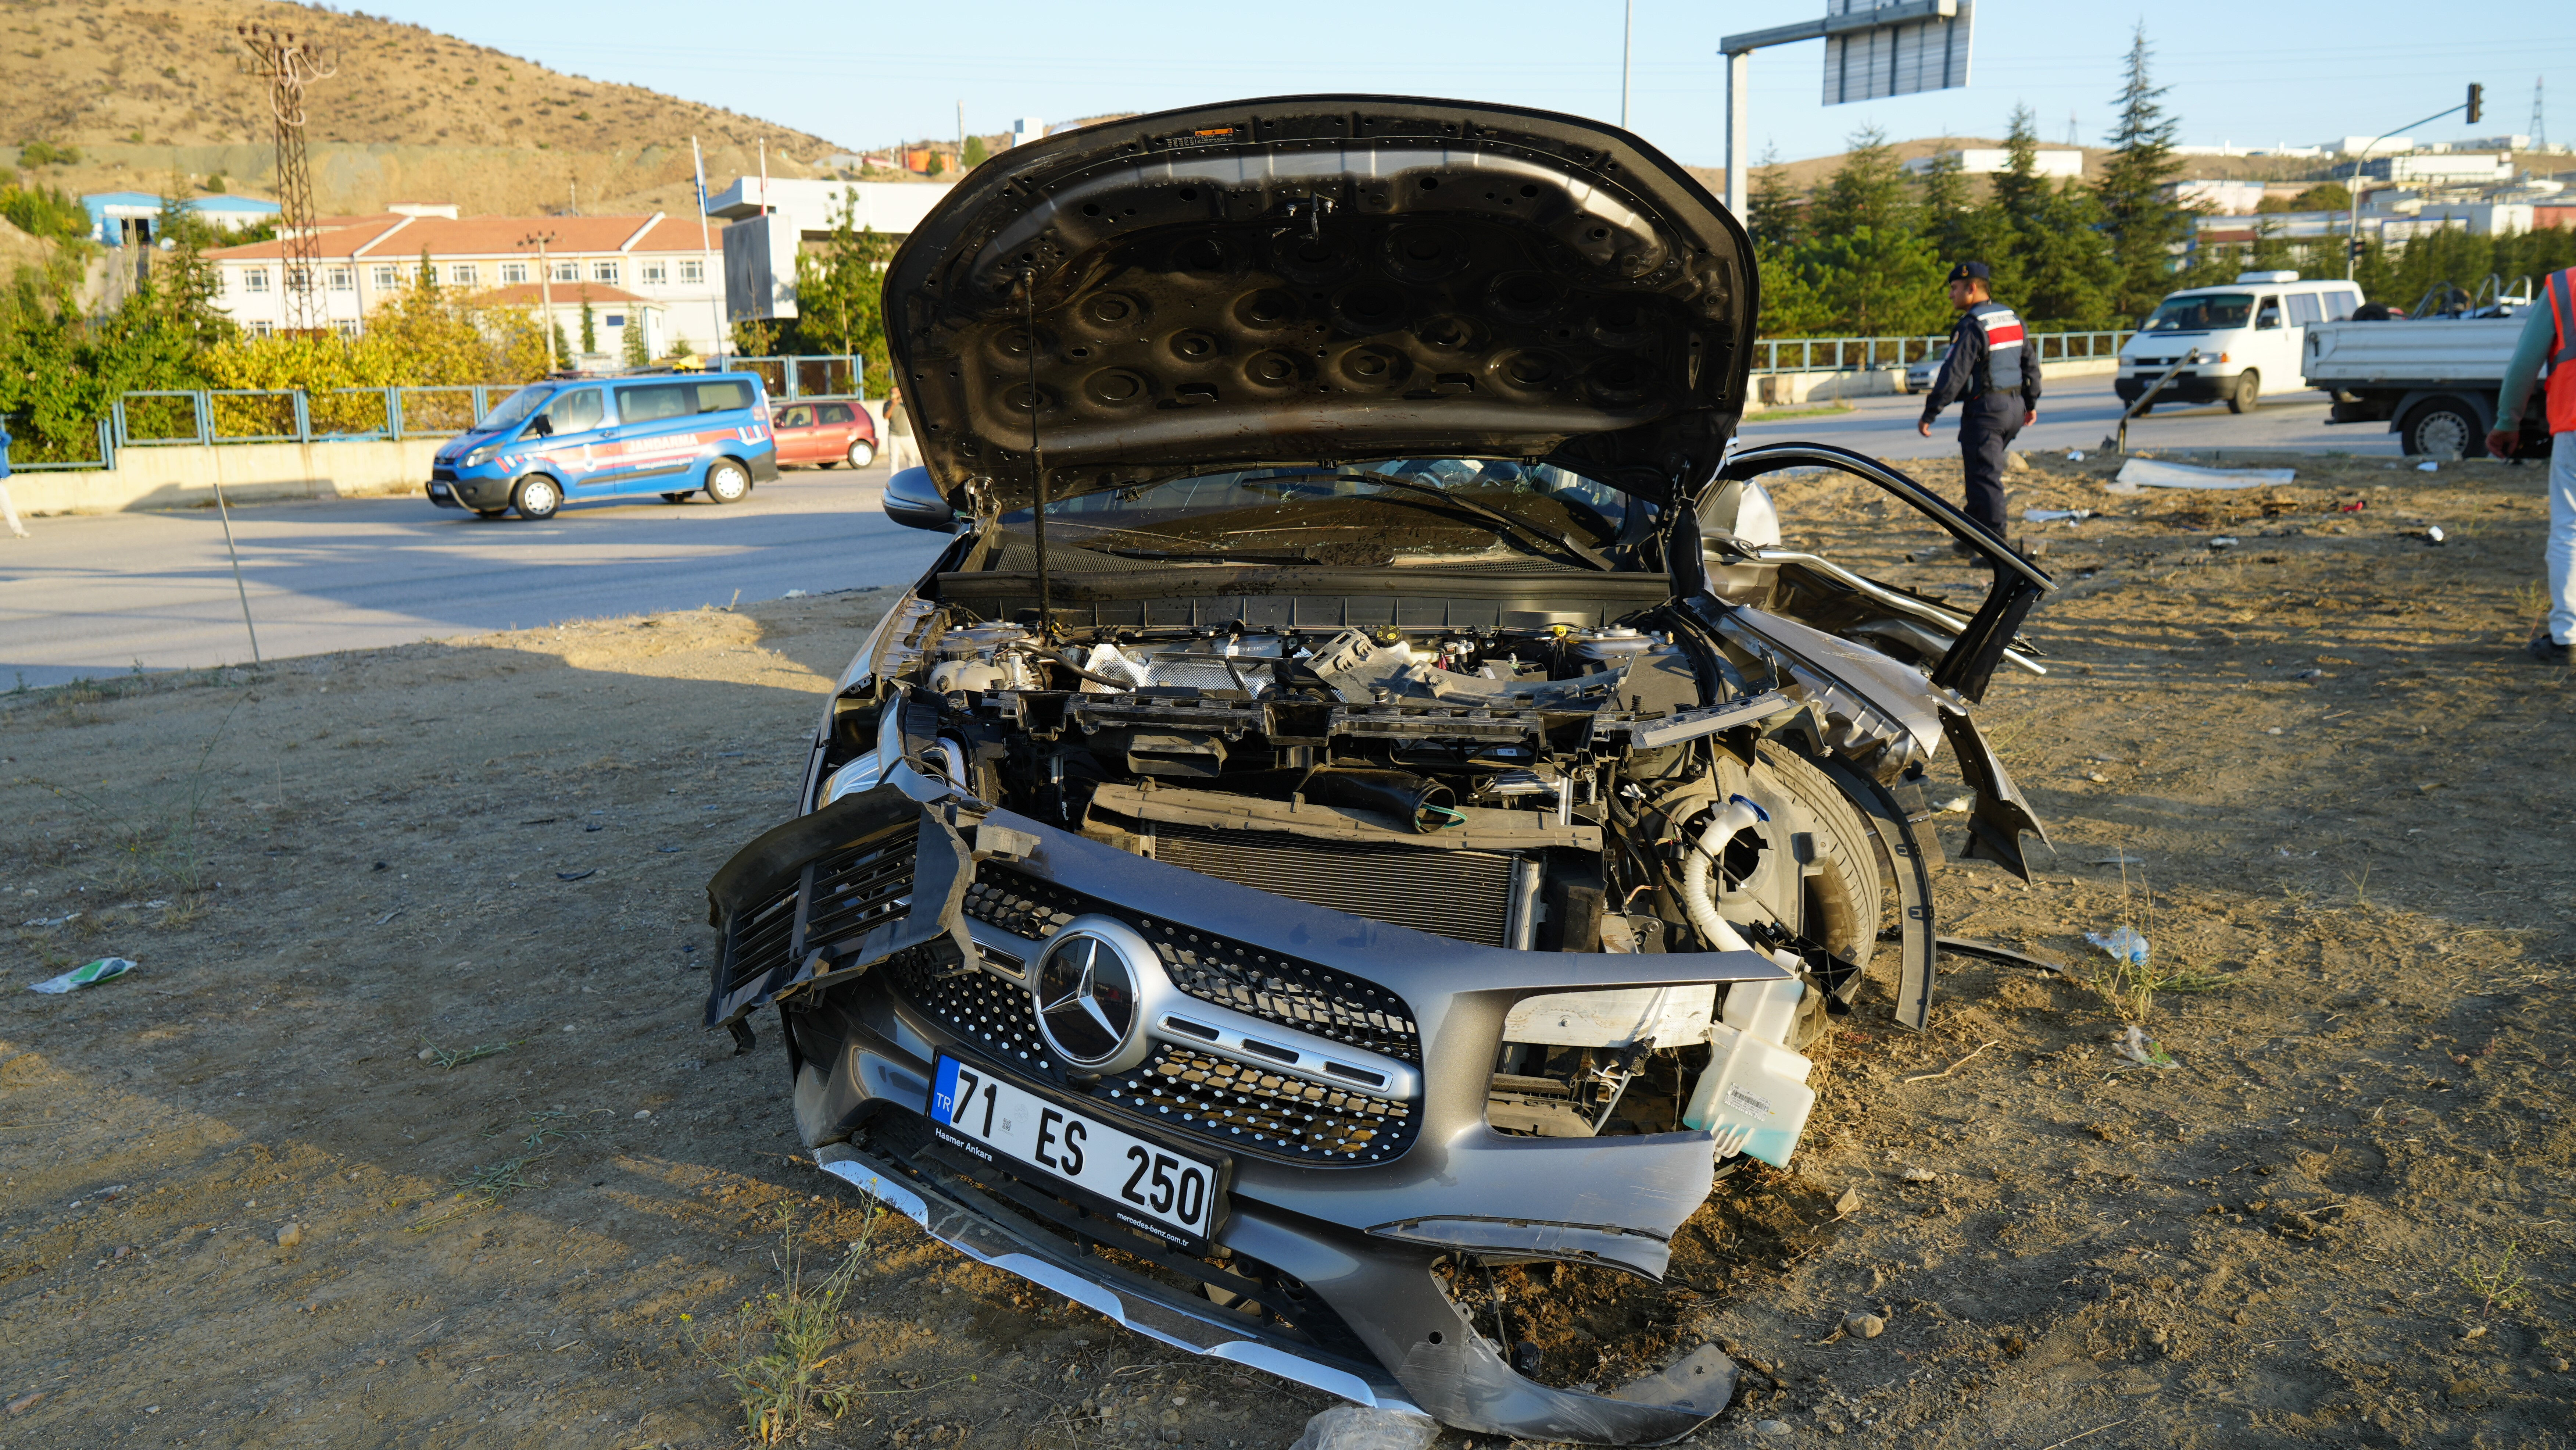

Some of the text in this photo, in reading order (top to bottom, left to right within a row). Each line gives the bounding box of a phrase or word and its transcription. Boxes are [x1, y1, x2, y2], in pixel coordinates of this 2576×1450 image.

[628, 433, 698, 453] JANDARMA
[937, 1092, 951, 1112] TR
[935, 1127, 992, 1162] Hasmer Ankara
[952, 1069, 1205, 1225] 71 ES 250
[1117, 1212, 1189, 1247] mercedes-benz.com.tr
